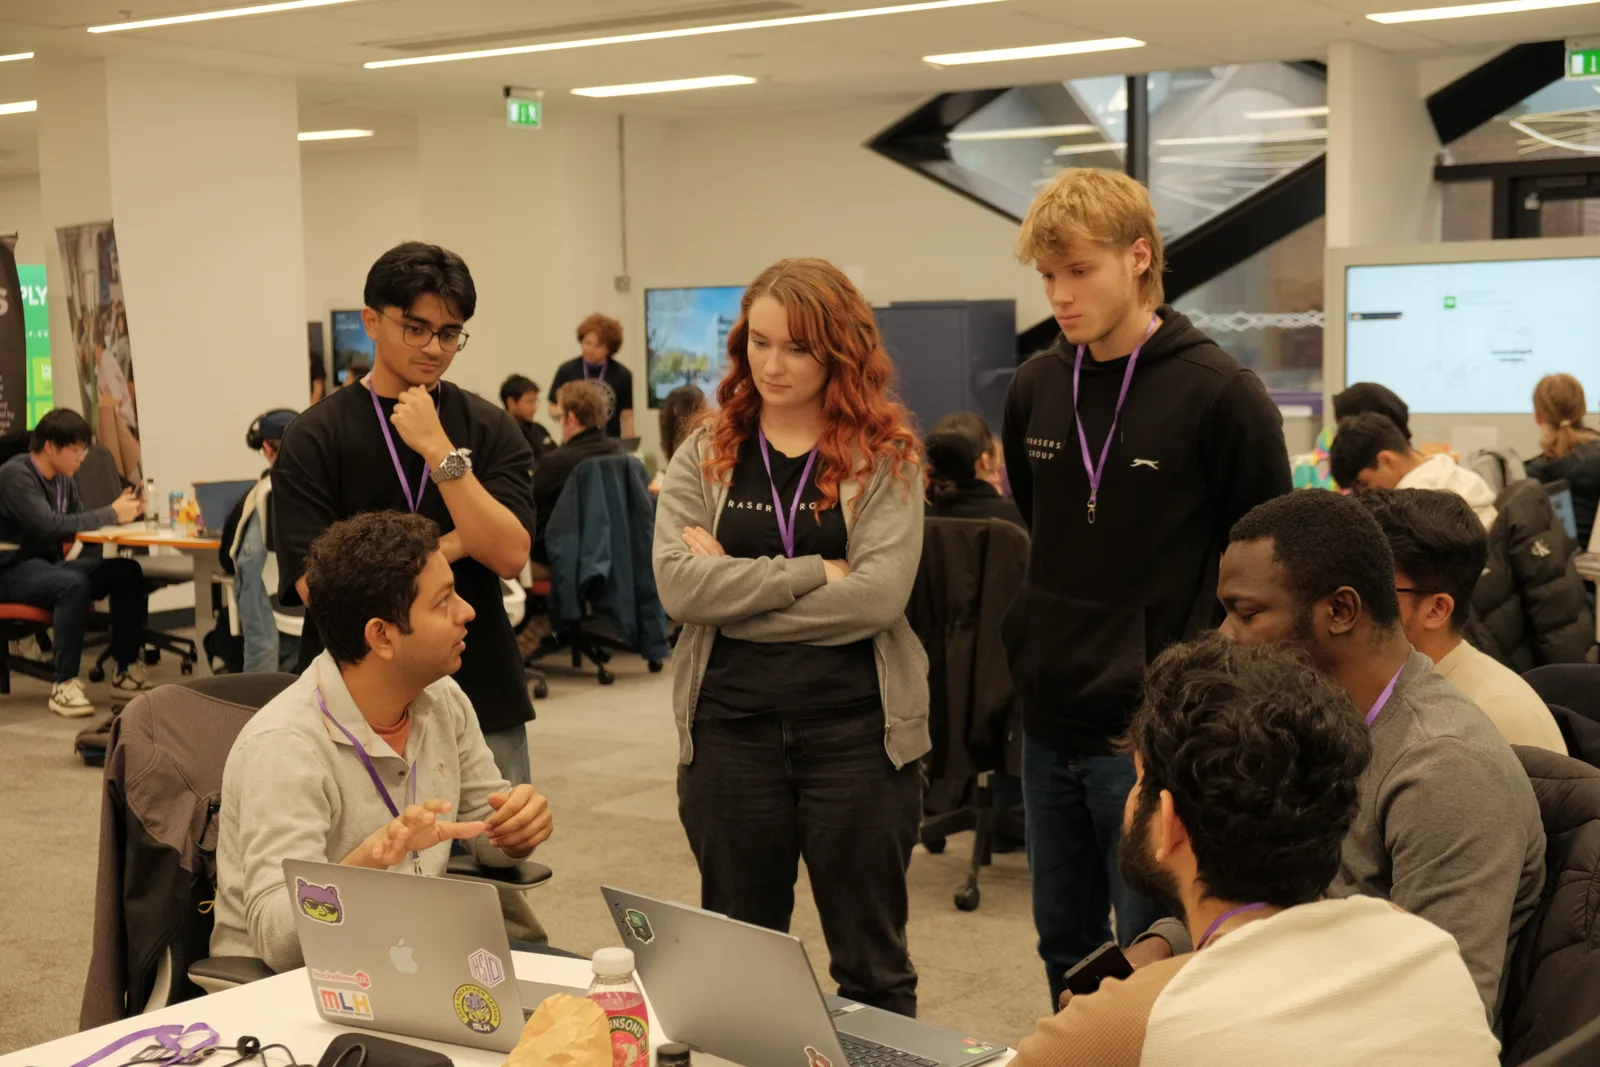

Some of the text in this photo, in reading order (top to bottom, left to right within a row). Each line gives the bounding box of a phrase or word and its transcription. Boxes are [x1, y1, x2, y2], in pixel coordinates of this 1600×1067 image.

[727, 499, 773, 513] RASER
[319, 989, 371, 1014] MLH
[472, 1022, 491, 1032] MLH
